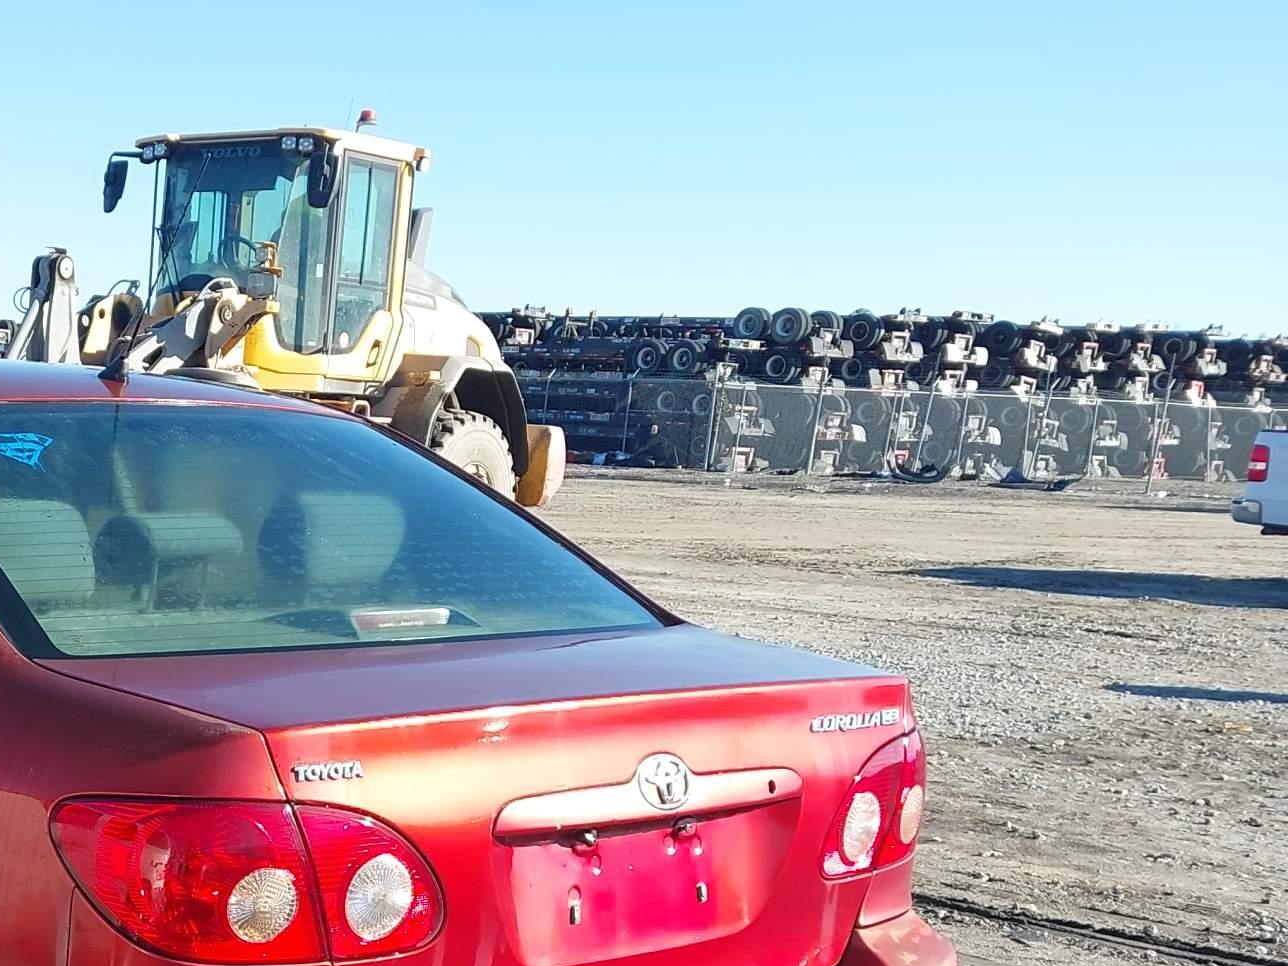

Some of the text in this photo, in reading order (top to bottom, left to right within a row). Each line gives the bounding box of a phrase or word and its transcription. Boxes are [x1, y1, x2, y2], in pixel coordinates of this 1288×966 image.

[201, 146, 261, 158] VOLVO
[810, 711, 880, 732] COROLLA
[293, 760, 364, 781] TOYOTA
